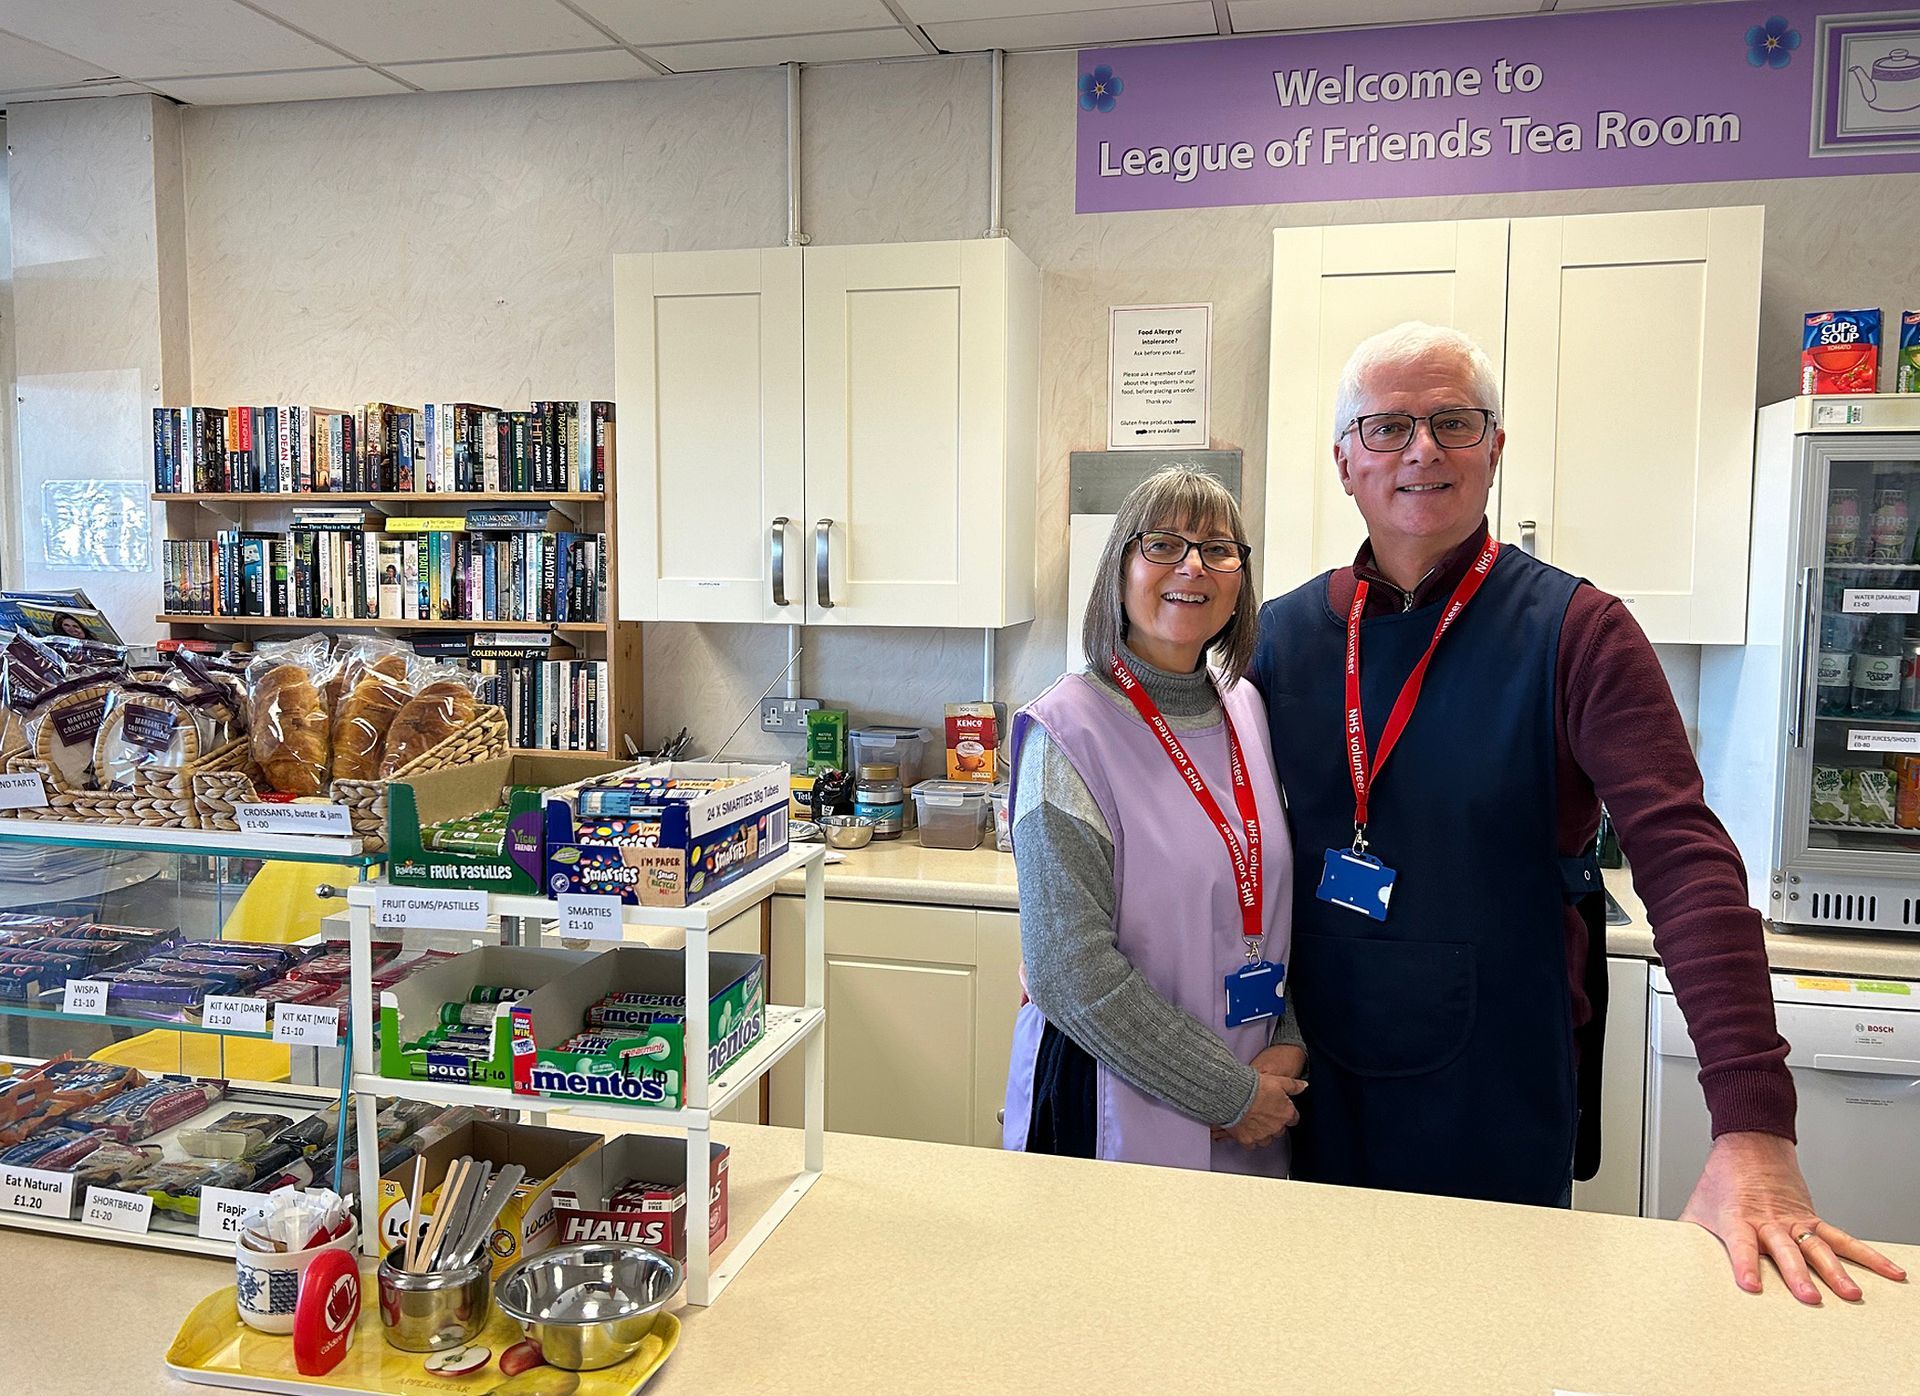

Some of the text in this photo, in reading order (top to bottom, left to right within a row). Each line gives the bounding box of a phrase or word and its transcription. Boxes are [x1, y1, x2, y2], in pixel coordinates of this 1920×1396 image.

[1273, 58, 1545, 108] Welcome to
[1098, 110, 1742, 184] League of Friends Tea Room
[1820, 332, 1860, 345] SOUP
[196, 412, 202, 422] NO
[280, 410, 289, 461] WILL DEAN
[557, 412, 566, 445] TRAPPED
[545, 465, 553, 483] SMITH
[559, 465, 567, 483] SMITH
[303, 553, 311, 566] TIES
[353, 549, 363, 583] Blasphemer
[418, 535, 428, 583] THE TRAITOR
[1478, 551, 1493, 574] NHS
[545, 553, 555, 589] HAYDER
[1347, 599, 1363, 675] NHS volunteer
[498, 649, 524, 657] NOLAN
[1115, 667, 1136, 690] NHS
[588, 679, 596, 701] DRESDEN
[63, 720, 92, 734] COUNTRY
[127, 724, 151, 736] COUNTRY
[134, 717, 170, 731] MARGARET'S
[956, 719, 983, 728] KENCO
[1872, 735, 1917, 743] JUICES/SHOOTS
[1151, 714, 1204, 792] NHS volunteer
[1348, 708, 1366, 794] NHS volunteer
[12, 779, 36, 789] TARTS
[707, 784, 780, 821] 24 X SMARTIES Tubes
[243, 808, 293, 818] CROISSANTS,
[294, 809, 317, 818] butter
[326, 811, 343, 821] jam
[247, 820, 270, 829] £1-00
[1246, 819, 1258, 844] NHS
[511, 829, 537, 846] VEGAN
[514, 843, 538, 852] FRIENDLY
[641, 857, 681, 867] I'M PAPER
[1219, 822, 1255, 907] NHS volunteer
[651, 880, 676, 889] RECYCLE
[382, 899, 480, 911] FRUIT GUMS/PASTILLES
[567, 906, 612, 918] SMARTIES
[382, 912, 407, 923] £1-10
[568, 919, 594, 931] £1-10
[74, 985, 100, 995] WISPA
[73, 998, 95, 1008] £1-10
[210, 1002, 265, 1014] KIT KAT [DARK
[209, 1015, 231, 1025] £1-10
[282, 1012, 337, 1026] KIT KAT [MILK
[281, 1026, 304, 1036] £1-10
[1867, 1025, 1895, 1033] BOSCH
[428, 1065, 467, 1077] POLO
[531, 1069, 665, 1100] mentos
[6, 1174, 63, 1193] Eat Natural
[385, 1183, 396, 1192] 20
[14, 1195, 42, 1209] £1.20
[92, 1194, 144, 1213] SHORTBREAD
[90, 1210, 113, 1221] £1-20
[566, 1217, 665, 1245] HALLS
